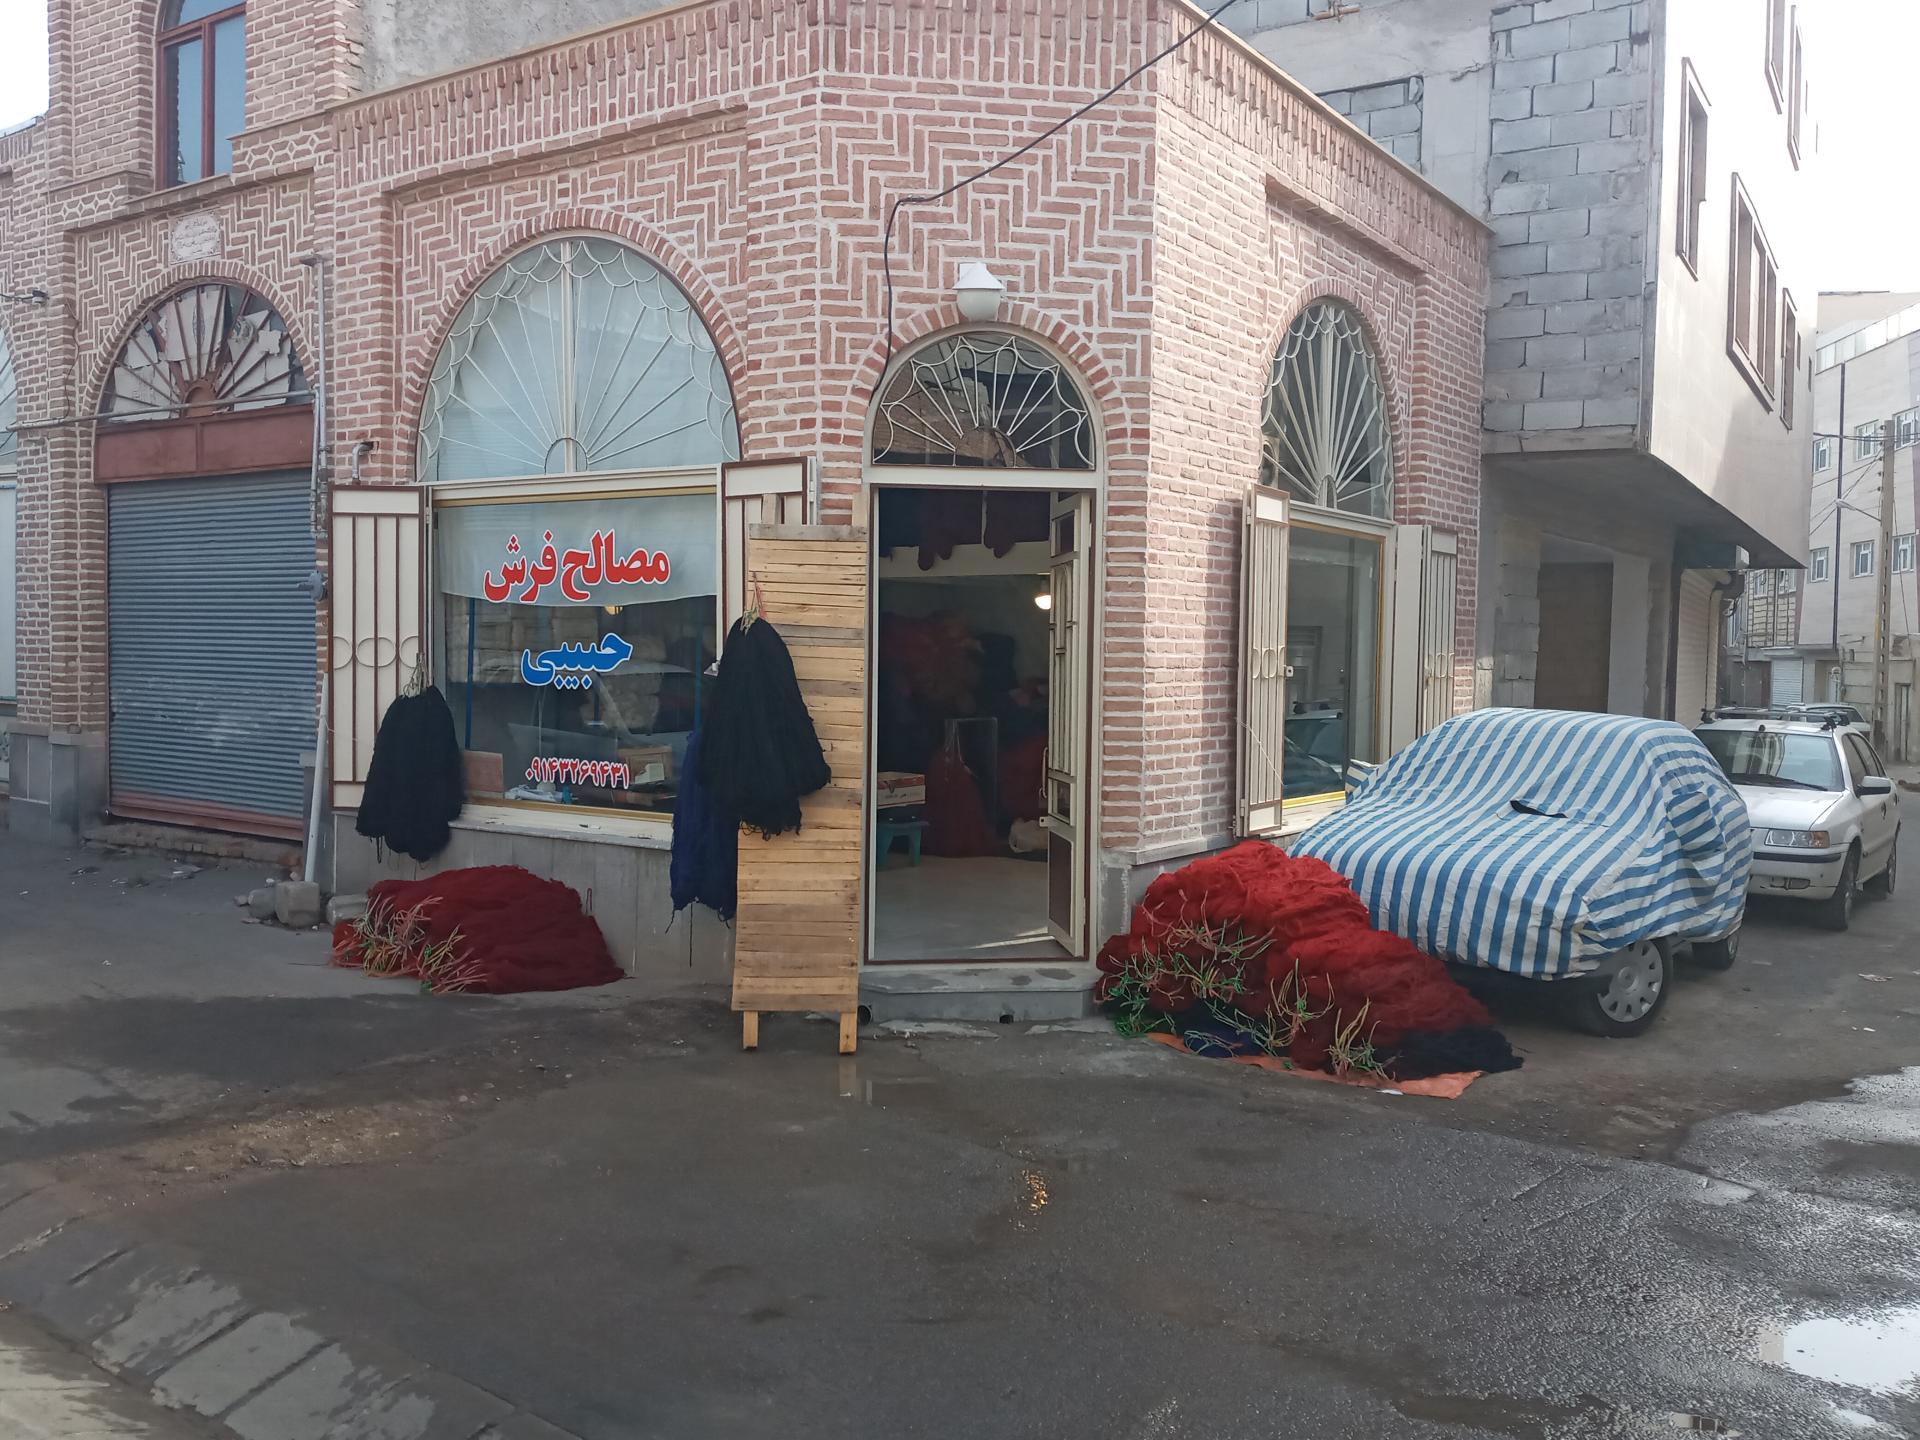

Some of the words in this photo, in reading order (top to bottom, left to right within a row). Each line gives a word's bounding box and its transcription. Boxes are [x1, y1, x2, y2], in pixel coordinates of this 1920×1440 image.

[483, 529, 559, 603] فرش
[560, 528, 671, 602] مصالح
[520, 632, 634, 690] حبیبی
[524, 756, 630, 790] ۰۹۱۴۳۲۶۹۴۳۱
